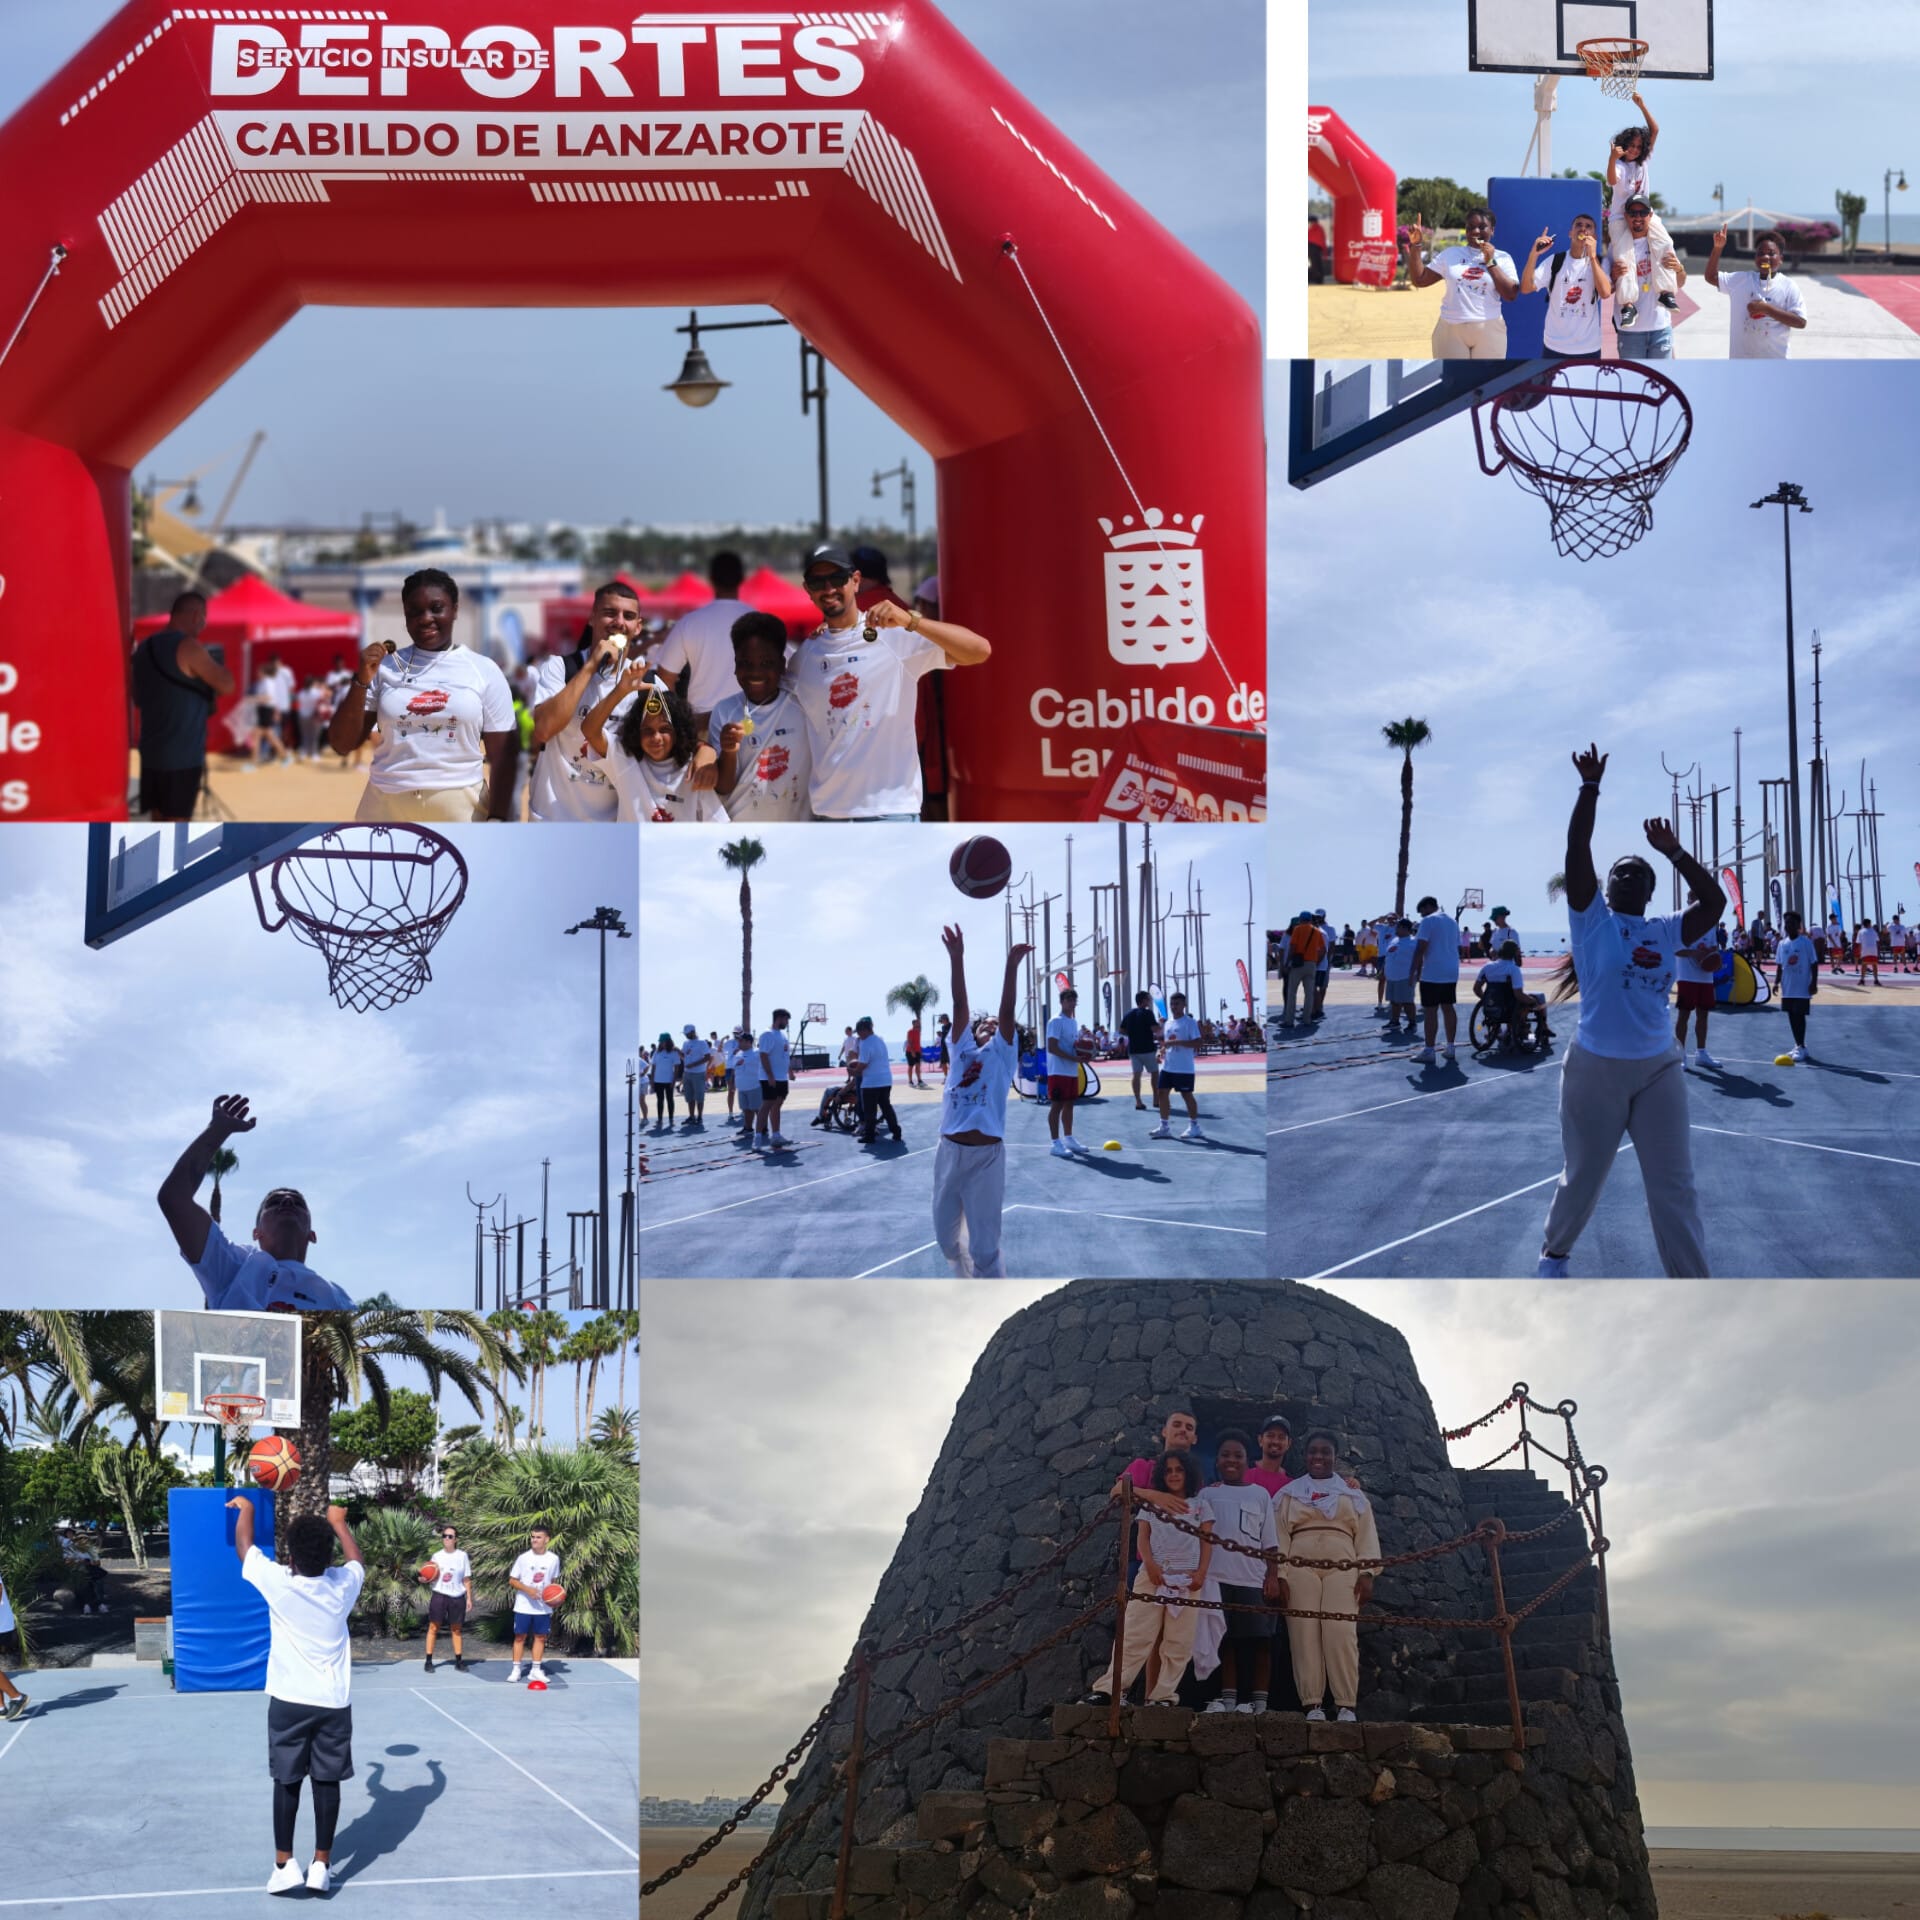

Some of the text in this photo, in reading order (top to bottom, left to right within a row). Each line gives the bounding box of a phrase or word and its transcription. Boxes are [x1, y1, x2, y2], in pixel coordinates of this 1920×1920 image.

[210, 25, 865, 98] DEPORTES
[238, 48, 550, 69] SERVICIO INSULAR DE
[236, 122, 845, 157] CABILDO DE LANZAROTE
[1030, 682, 1265, 729] Cabildo de
